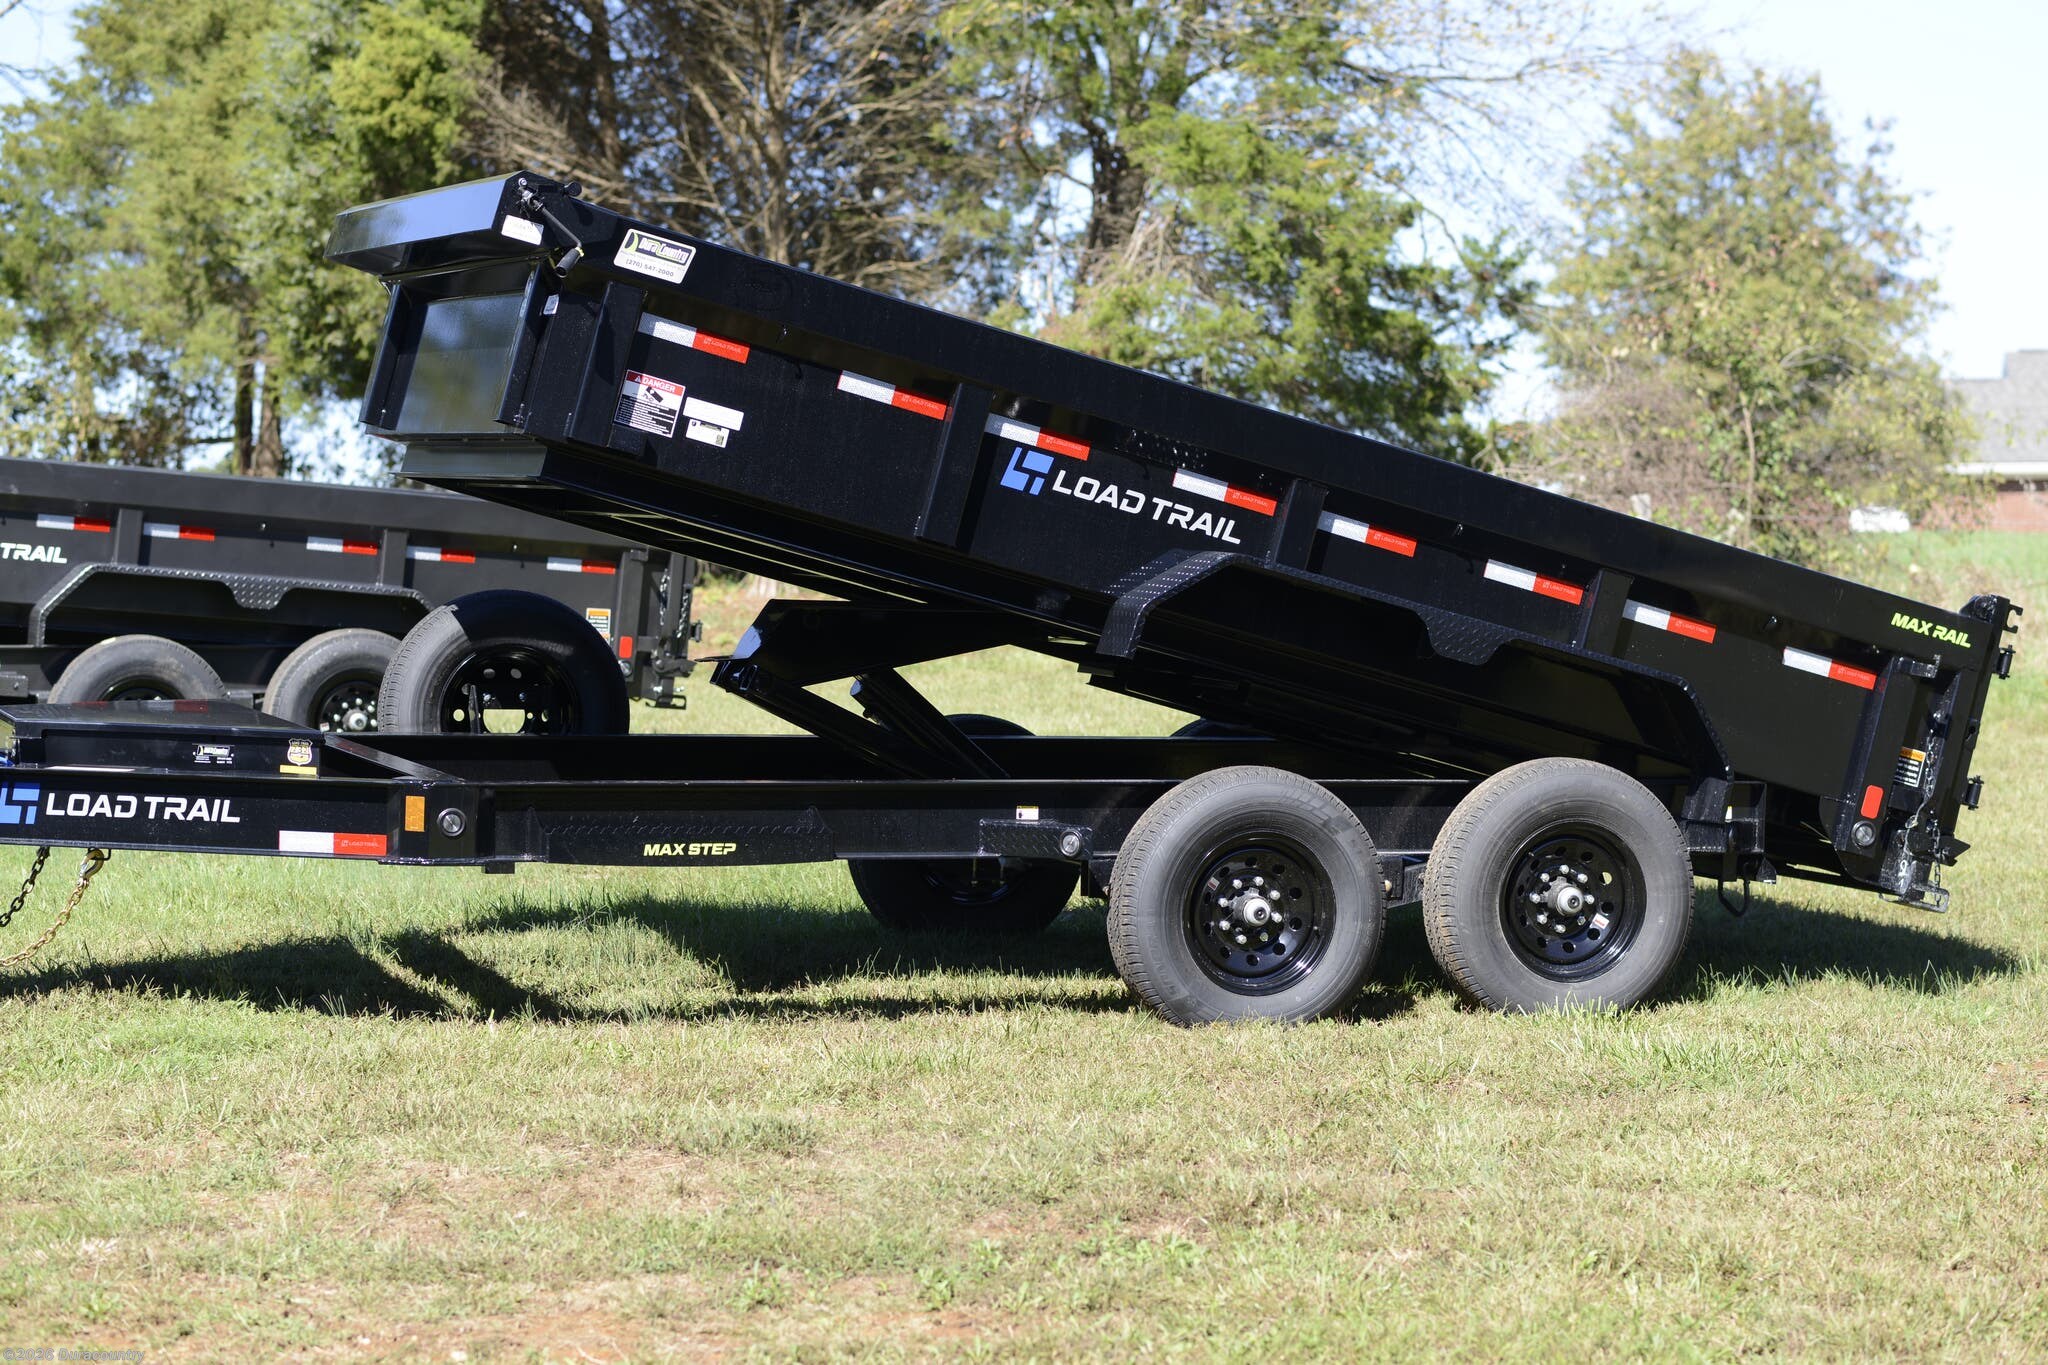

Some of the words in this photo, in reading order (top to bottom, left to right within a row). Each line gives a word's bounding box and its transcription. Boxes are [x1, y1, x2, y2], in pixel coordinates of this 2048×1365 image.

[626, 259, 643, 269] (270)
[644, 264, 674, 277] 547-2000
[643, 377, 676, 393] DANGER
[1052, 469, 1146, 514] LOAD
[1151, 497, 1241, 545] TRAIL
[0, 542, 68, 564] TRAIL
[1891, 612, 1933, 636] MAX
[1932, 625, 1971, 648] RAIL
[46, 792, 138, 819] LOAD
[144, 796, 241, 823] TRAIL
[643, 843, 686, 856] MAX
[688, 843, 737, 855] STEP
